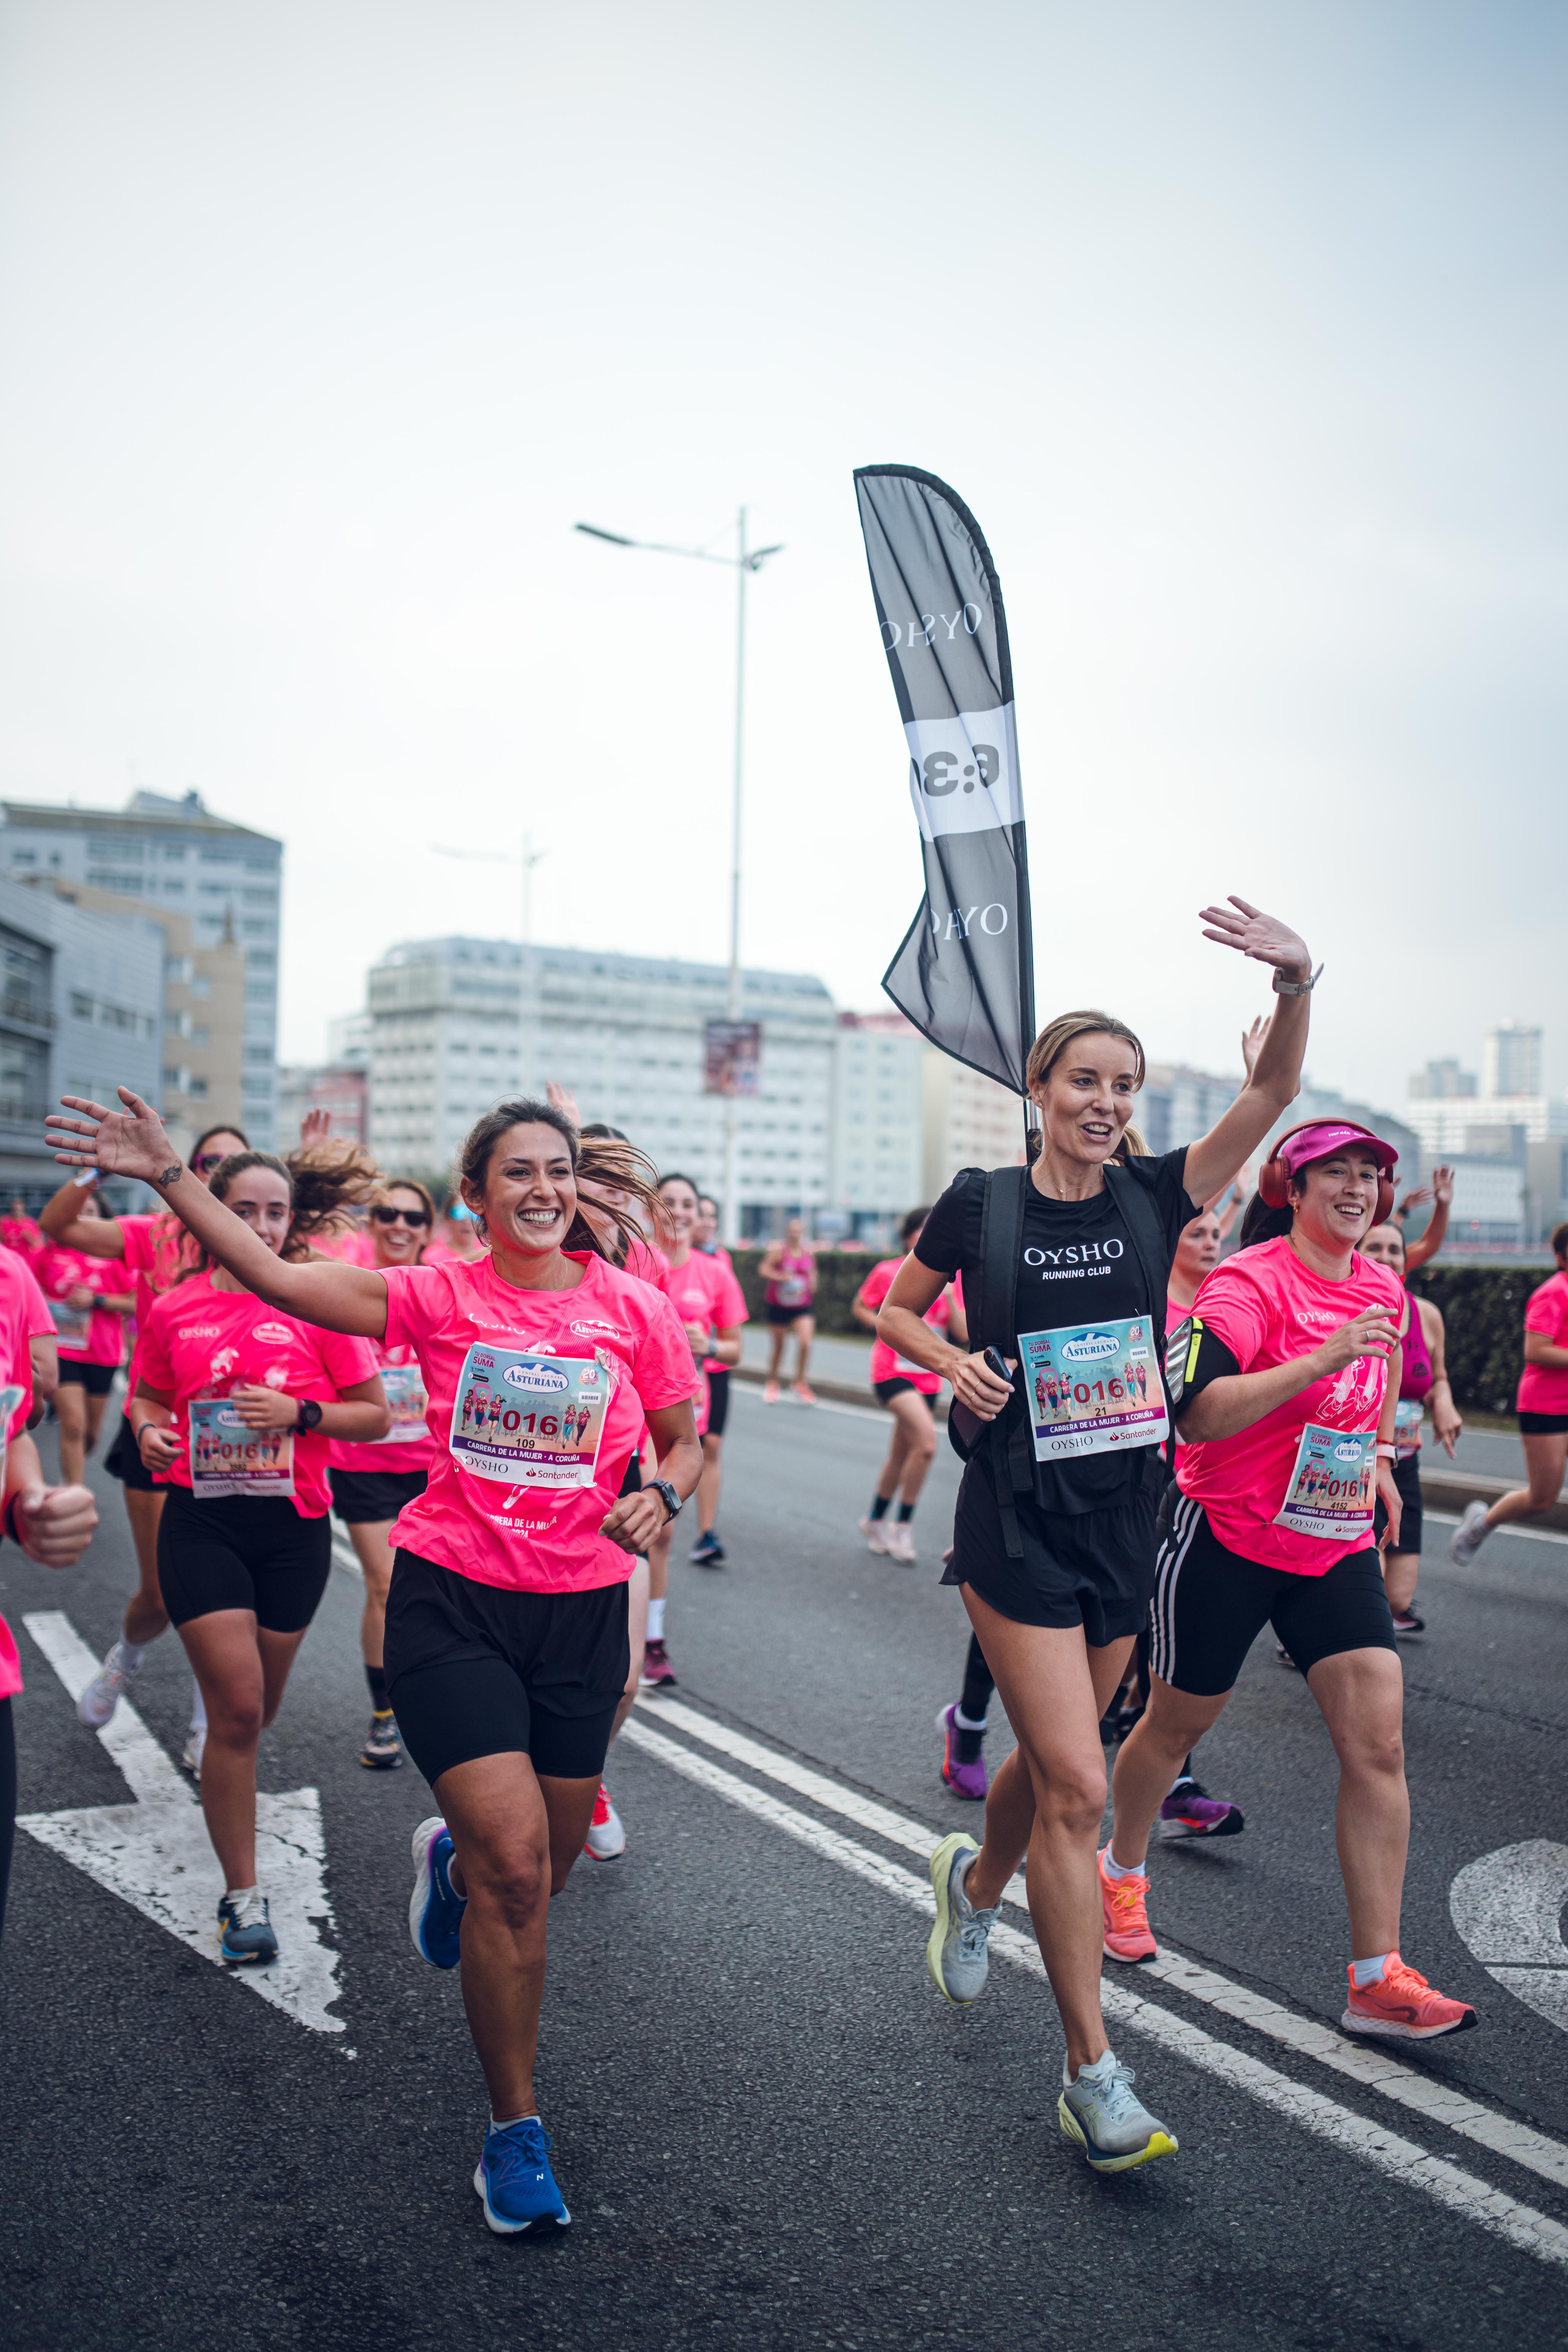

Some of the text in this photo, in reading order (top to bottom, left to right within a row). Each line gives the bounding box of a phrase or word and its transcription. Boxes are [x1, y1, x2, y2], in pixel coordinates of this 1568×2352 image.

[1024, 1239, 1123, 1265] OYSHO
[1043, 1266, 1111, 1280] RUNNING CLUB
[1298, 1311, 1336, 1324] OYSHO
[1130, 1326, 1140, 1336] 20
[1029, 1344, 1051, 1353] SUMA
[1066, 1343, 1118, 1357] ASTURIANA
[473, 1356, 494, 1368] SUMA
[507, 1370, 563, 1388] ASTURIANA
[583, 1369, 595, 1379] 20
[1074, 1378, 1124, 1403] 016
[1095, 1407, 1106, 1416] 21
[503, 1410, 558, 1435] 016
[1050, 1423, 1078, 1433] CARRERA
[1099, 1417, 1120, 1426] MUJER
[1130, 1411, 1154, 1421] CORUÑA
[1120, 1428, 1156, 1440] Santander
[516, 1438, 535, 1449] 109
[1051, 1436, 1093, 1450] OYSHO
[1310, 1437, 1331, 1446] SUMA
[221, 1443, 258, 1459] 016
[467, 1441, 496, 1454] CARRERA
[519, 1451, 542, 1460] MUJER
[555, 1454, 580, 1462] CORUÑA
[1336, 1446, 1360, 1456] ASTURIANA
[465, 1455, 508, 1473] OYSHO
[538, 1470, 578, 1479] Santander
[1328, 1479, 1358, 1497] 016
[1296, 1506, 1318, 1515] CARRERA
[514, 1518, 524, 1528] DE
[526, 1520, 534, 1529] LA
[1290, 1518, 1324, 1530] OYSHO
